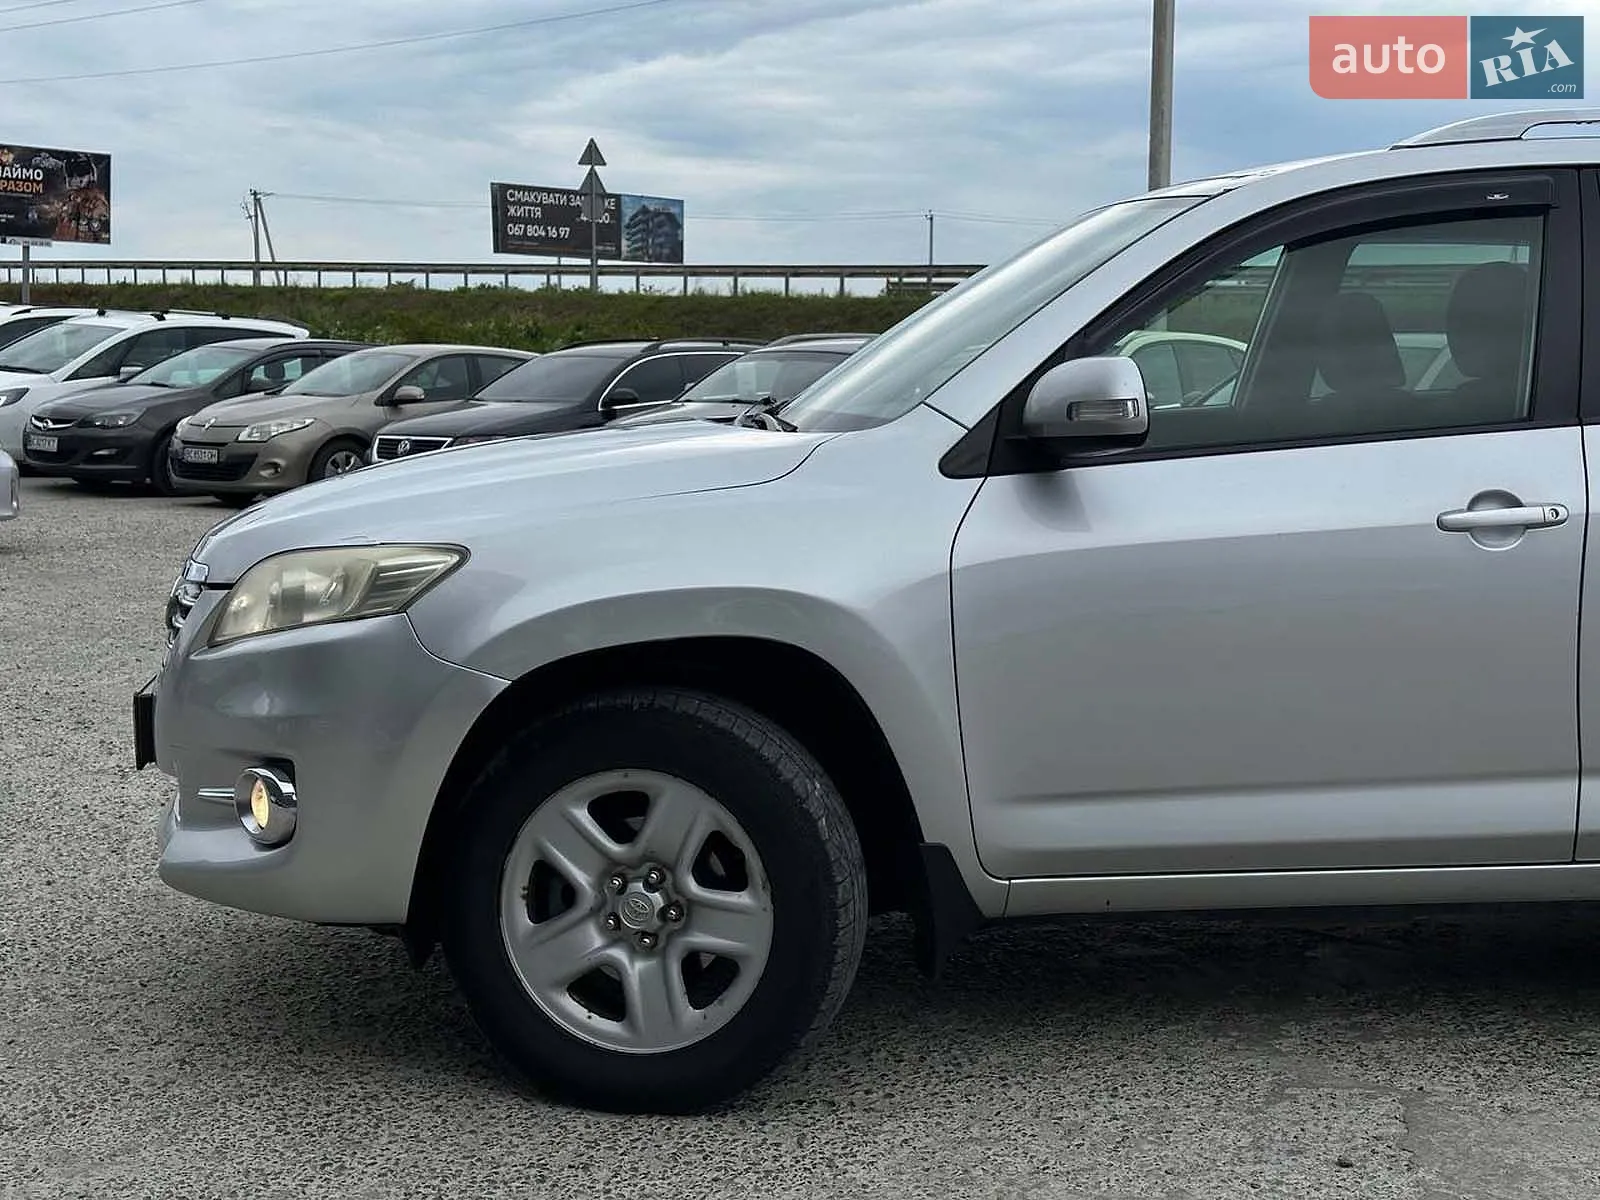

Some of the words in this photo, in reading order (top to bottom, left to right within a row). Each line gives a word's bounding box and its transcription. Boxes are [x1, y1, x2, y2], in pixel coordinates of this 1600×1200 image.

[0, 164, 44, 181] АЙМО
[506, 189, 567, 207] СМАКУВАТИ
[507, 205, 542, 219] ЖИТТЯ
[507, 224, 525, 236] 067
[526, 225, 546, 237] 804
[547, 226, 558, 239] 16
[559, 227, 571, 239] 97
